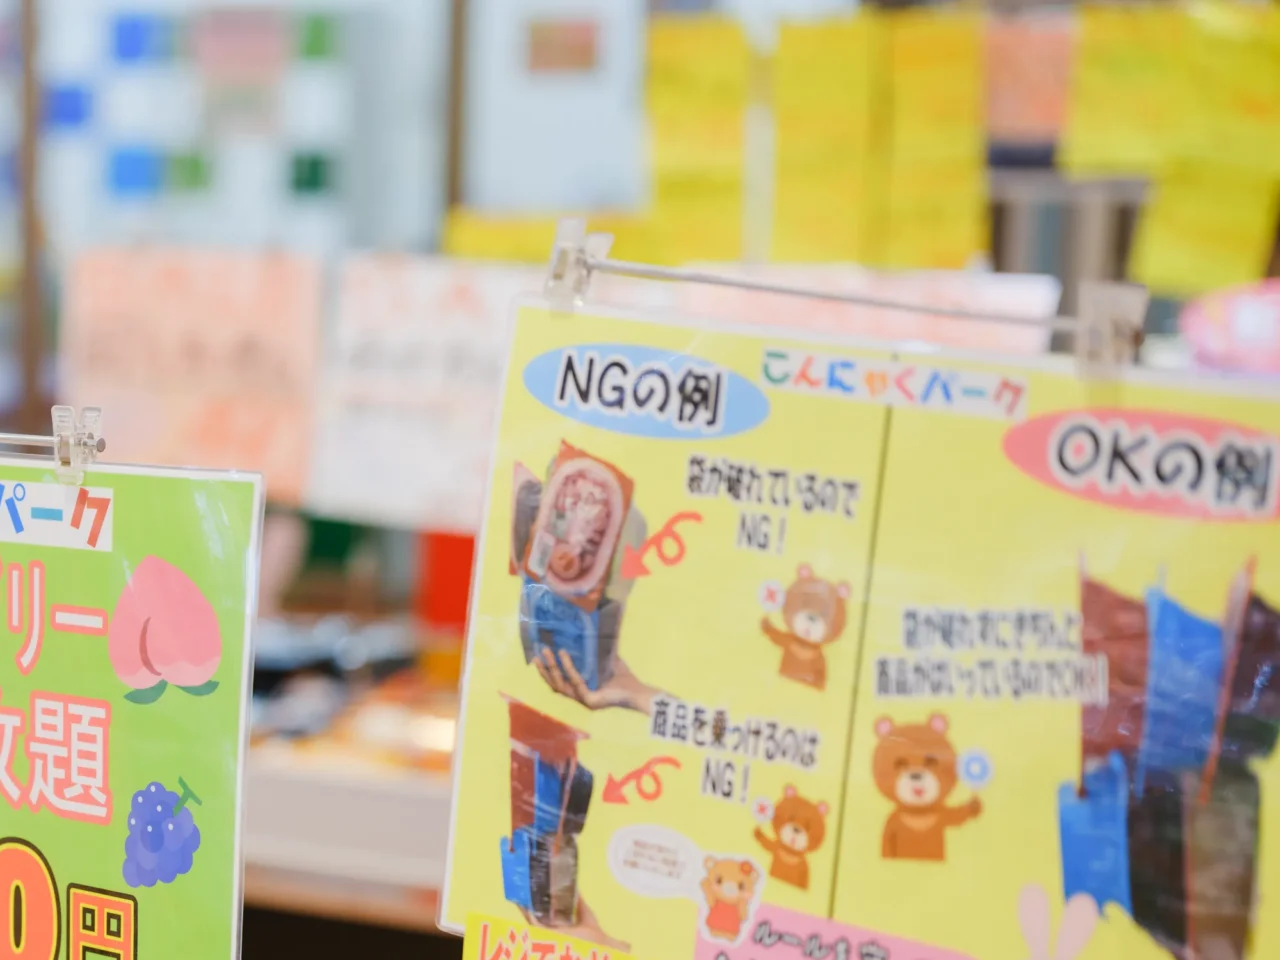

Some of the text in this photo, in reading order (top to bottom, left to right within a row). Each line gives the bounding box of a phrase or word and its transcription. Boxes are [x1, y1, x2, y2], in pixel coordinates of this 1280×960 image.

[556, 352, 723, 428] NGの例
[761, 349, 1027, 415] こんにゃくパーク
[1053, 423, 1275, 509] OKの例
